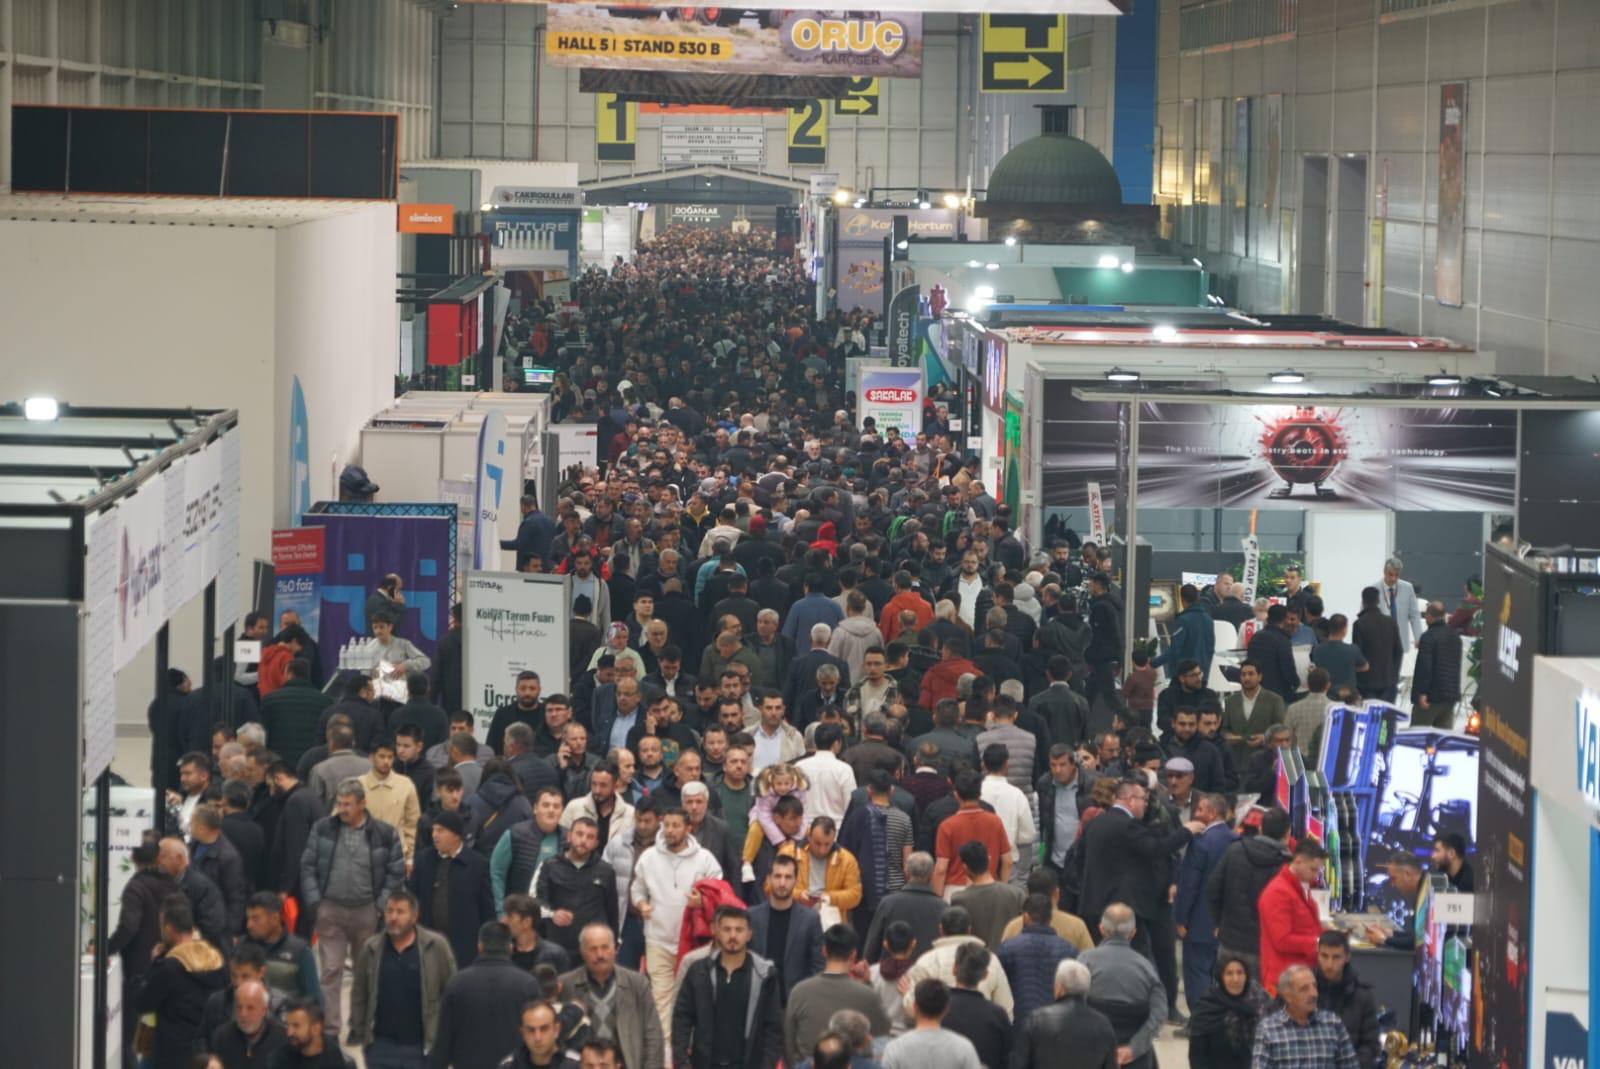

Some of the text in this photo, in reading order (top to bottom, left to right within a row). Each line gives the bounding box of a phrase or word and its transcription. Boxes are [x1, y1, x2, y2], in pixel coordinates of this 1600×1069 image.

[558, 36, 721, 55] HALL 5 STAND 530 B
[791, 18, 904, 57] ORUÇ
[606, 93, 627, 141] 1
[793, 98, 822, 146] 2
[495, 221, 569, 232] FUTURE
[897, 311, 910, 367] oyaltech
[870, 390, 913, 402] SAKALAK
[476, 608, 502, 623] Konya
[531, 612, 555, 624] Fuarı
[1575, 697, 1600, 802] VA
